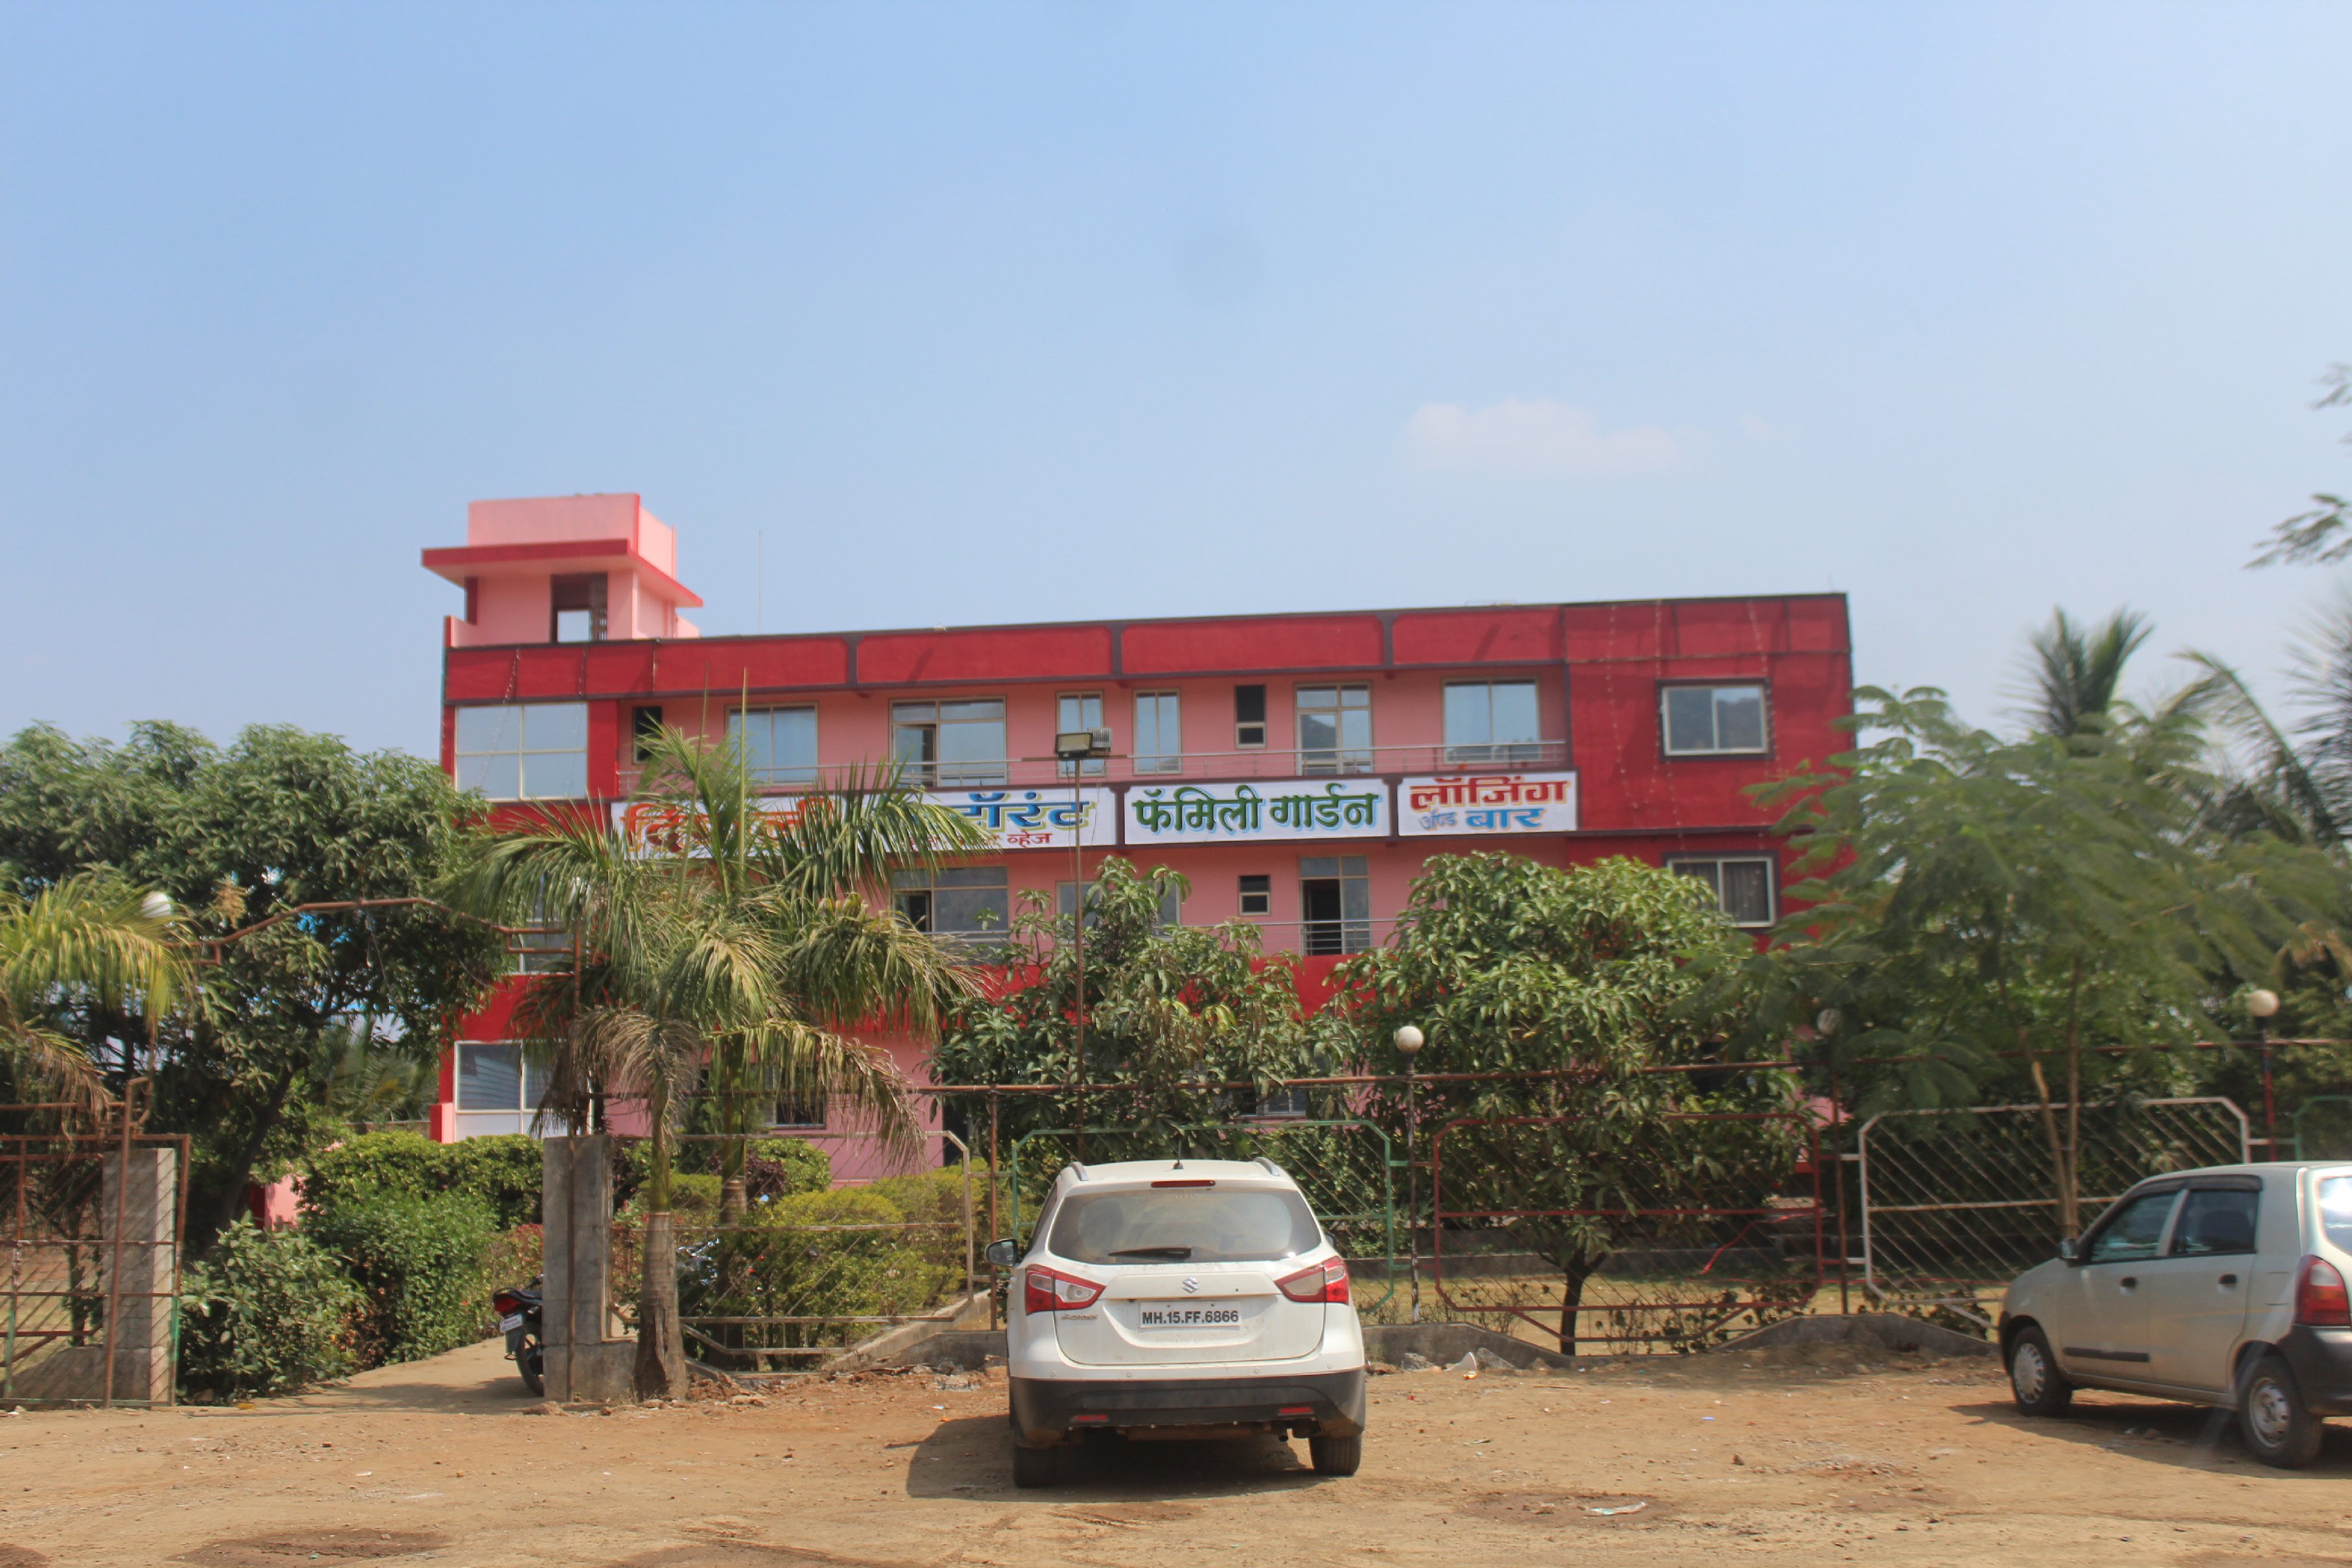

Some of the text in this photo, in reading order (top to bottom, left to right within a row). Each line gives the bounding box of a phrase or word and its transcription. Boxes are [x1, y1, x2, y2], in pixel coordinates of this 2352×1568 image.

[1409, 776, 1568, 811] लॉजिंग
[1131, 782, 1380, 833] फॅमिली गार्डन
[1464, 808, 1545, 829] बार
[1006, 829, 1053, 849] व्हेज
[1142, 1310, 1240, 1325] MH.15.FF.6866
